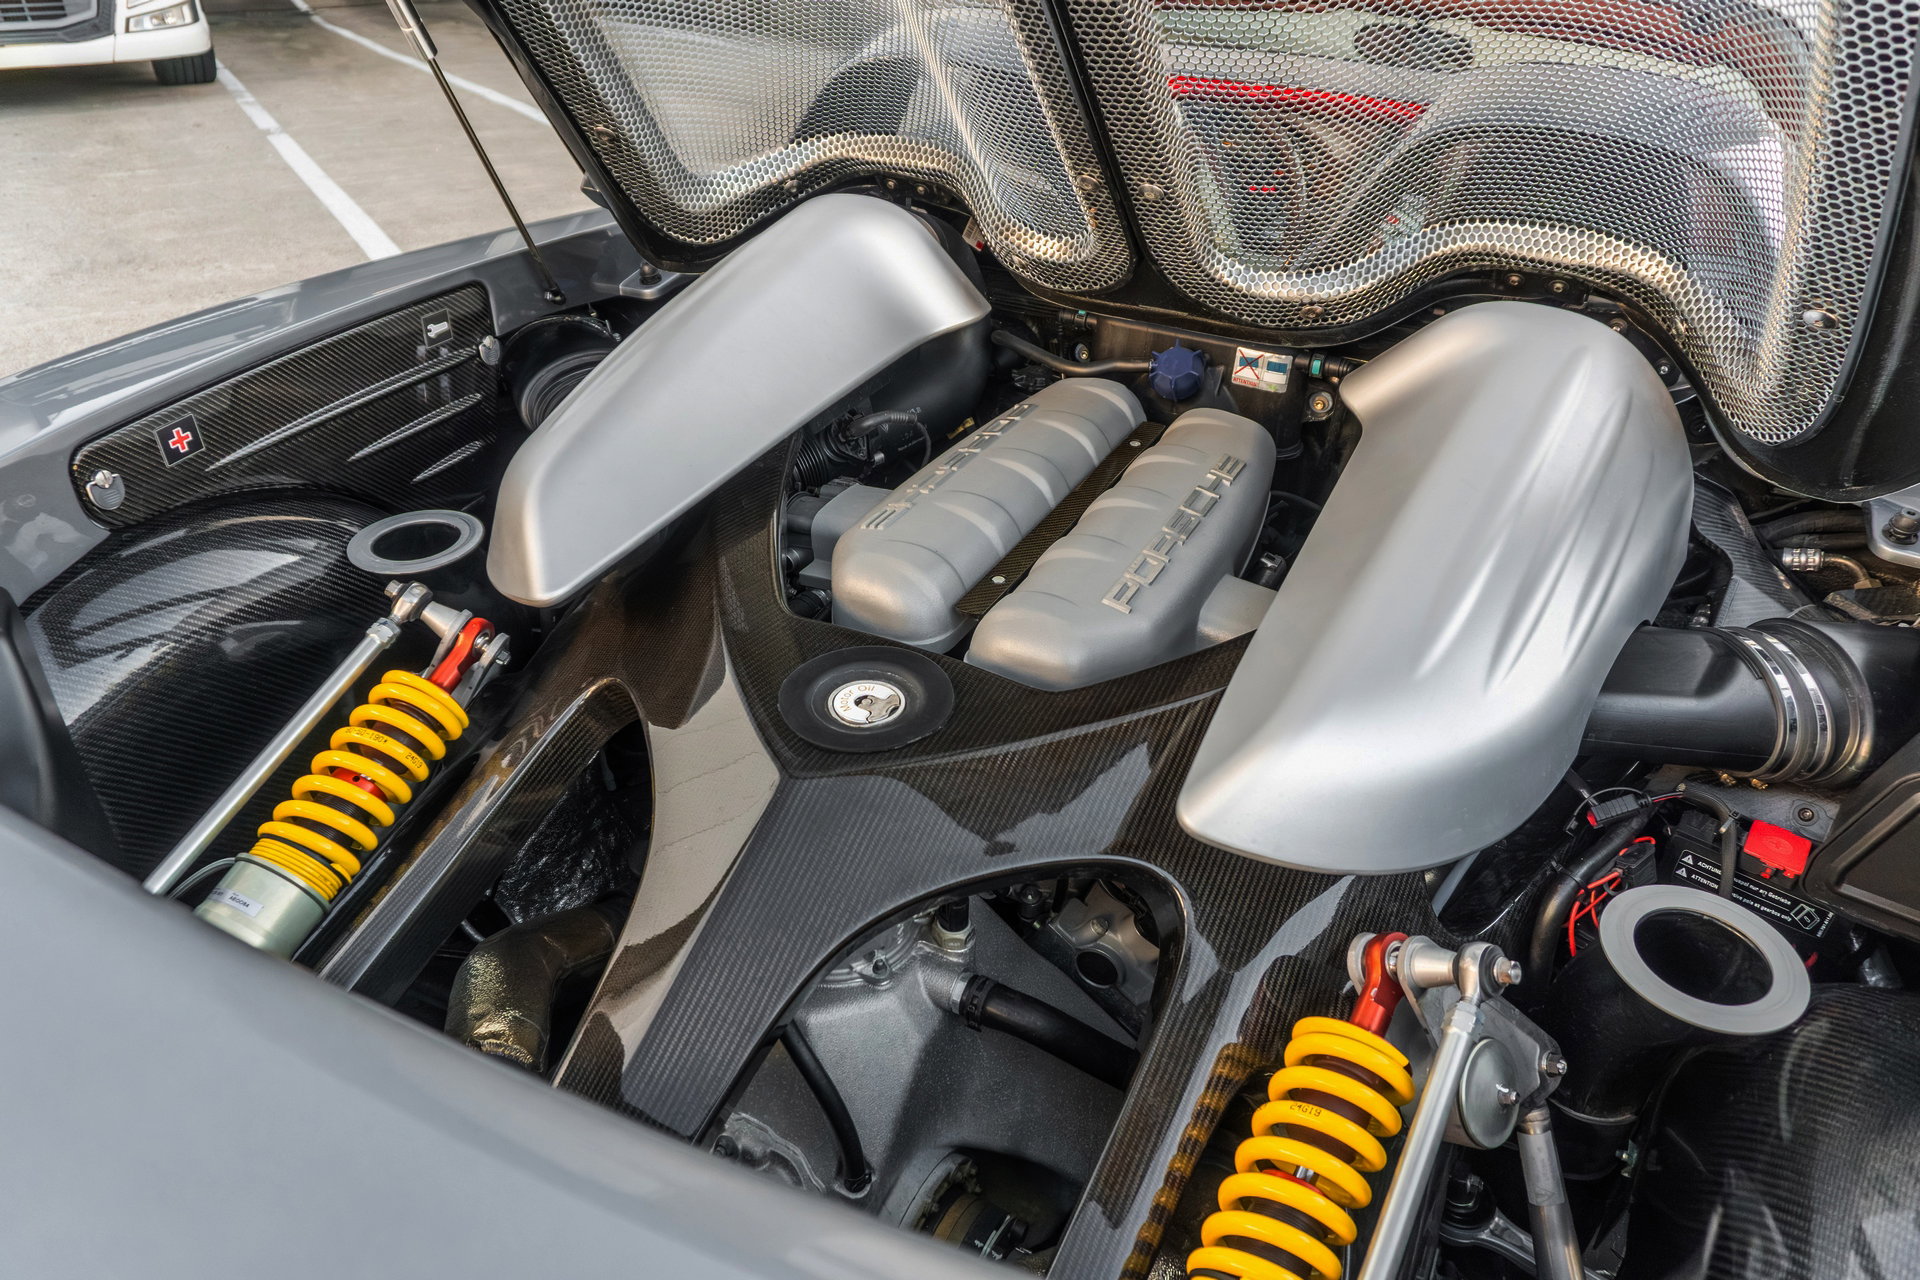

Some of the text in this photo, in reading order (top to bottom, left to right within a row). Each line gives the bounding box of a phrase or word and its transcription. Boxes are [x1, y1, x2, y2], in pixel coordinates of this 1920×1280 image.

[860, 403, 1038, 530] PORSCHE
[1101, 453, 1248, 615] PORSCHE
[840, 689, 854, 712] Motor
[1691, 874, 1719, 890] ATTENTION
